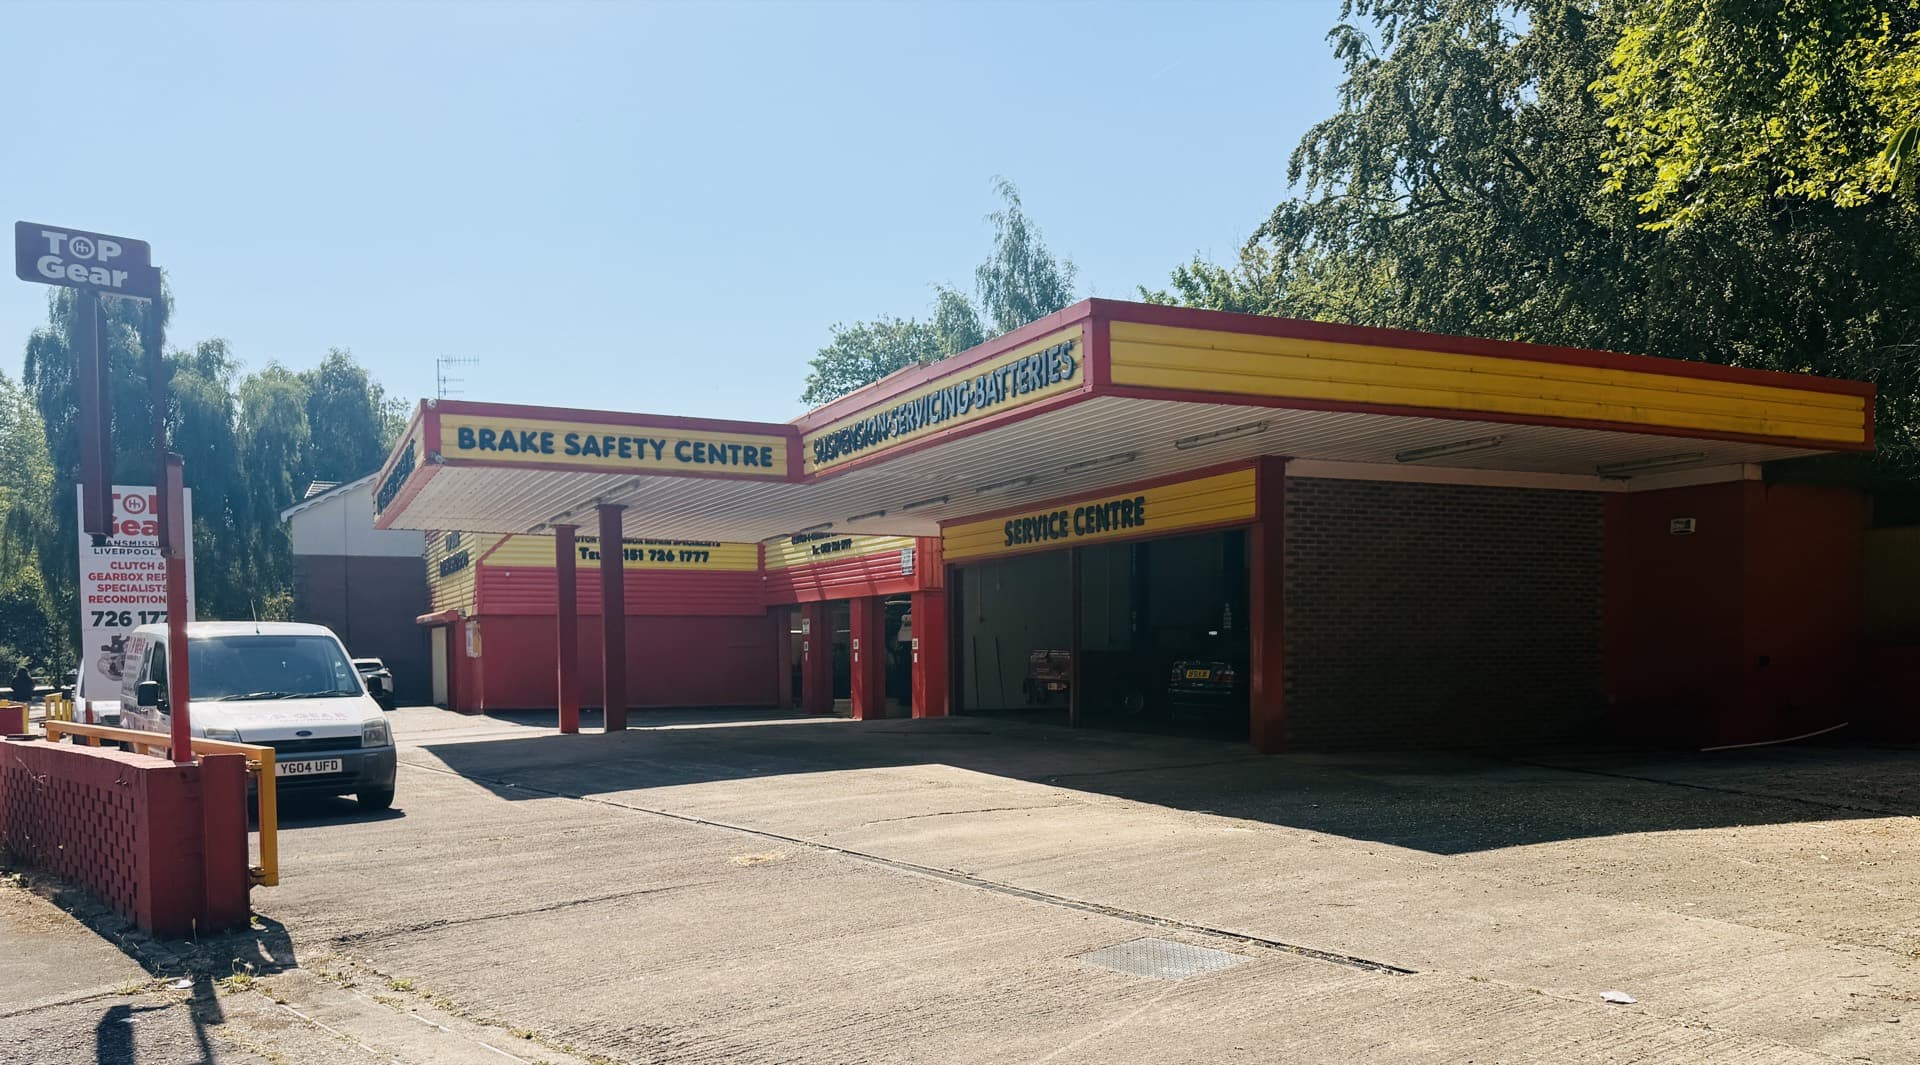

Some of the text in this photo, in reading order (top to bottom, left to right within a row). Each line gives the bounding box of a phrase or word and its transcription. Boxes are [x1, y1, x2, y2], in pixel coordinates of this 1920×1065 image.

[41, 230, 122, 262] TOP
[37, 255, 128, 288] Gear
[458, 427, 773, 467] BRAKE SAFETY CENTRE
[1004, 496, 1145, 546] SERVICE CENTRE
[93, 547, 157, 556] LIVERPOOL
[623, 548, 644, 561] 151
[648, 550, 675, 562] 726
[679, 551, 709, 563] 1777
[110, 561, 165, 571] CLUTCH &
[88, 572, 143, 582] GEARBOX
[91, 610, 132, 627] 726
[281, 760, 338, 774] YG04 UFD
